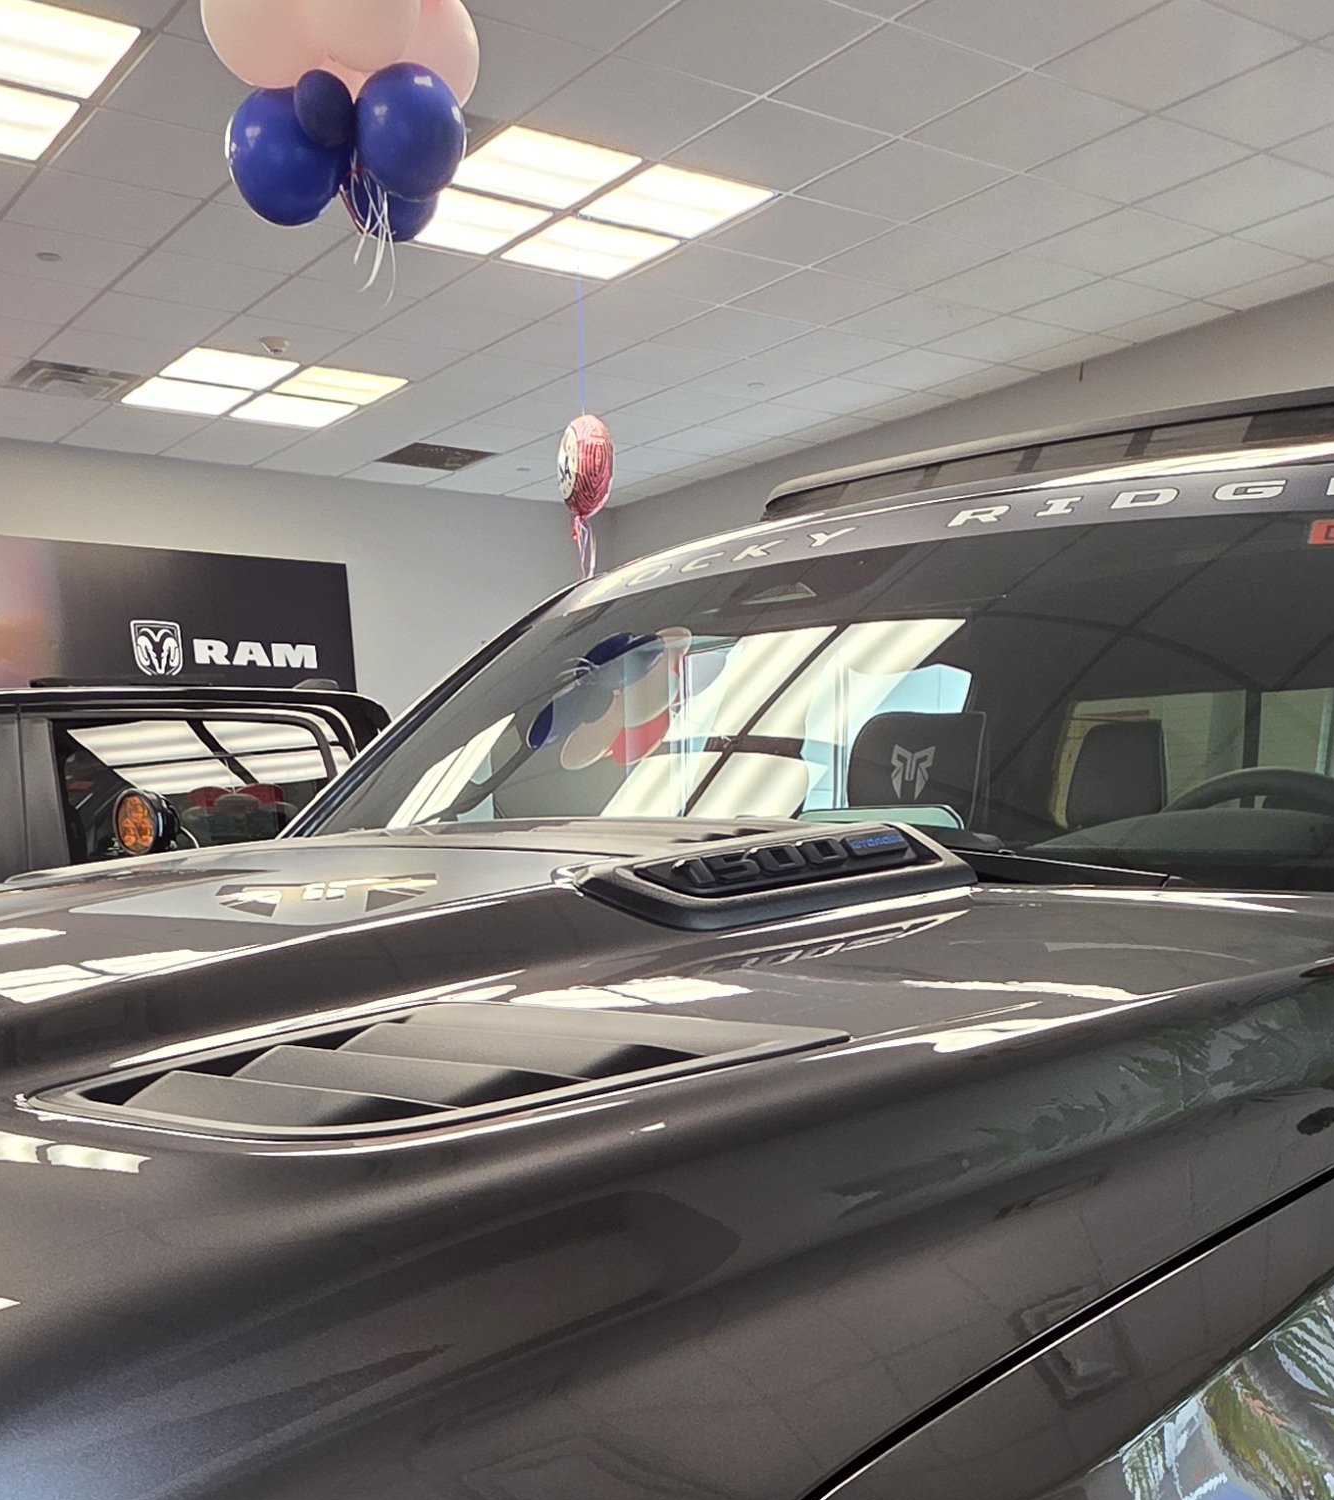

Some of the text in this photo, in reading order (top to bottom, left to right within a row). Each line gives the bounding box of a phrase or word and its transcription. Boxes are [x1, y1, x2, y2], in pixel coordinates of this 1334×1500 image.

[625, 526, 858, 587] OCKY
[192, 638, 319, 669] RAM
[673, 837, 849, 885] 1500
